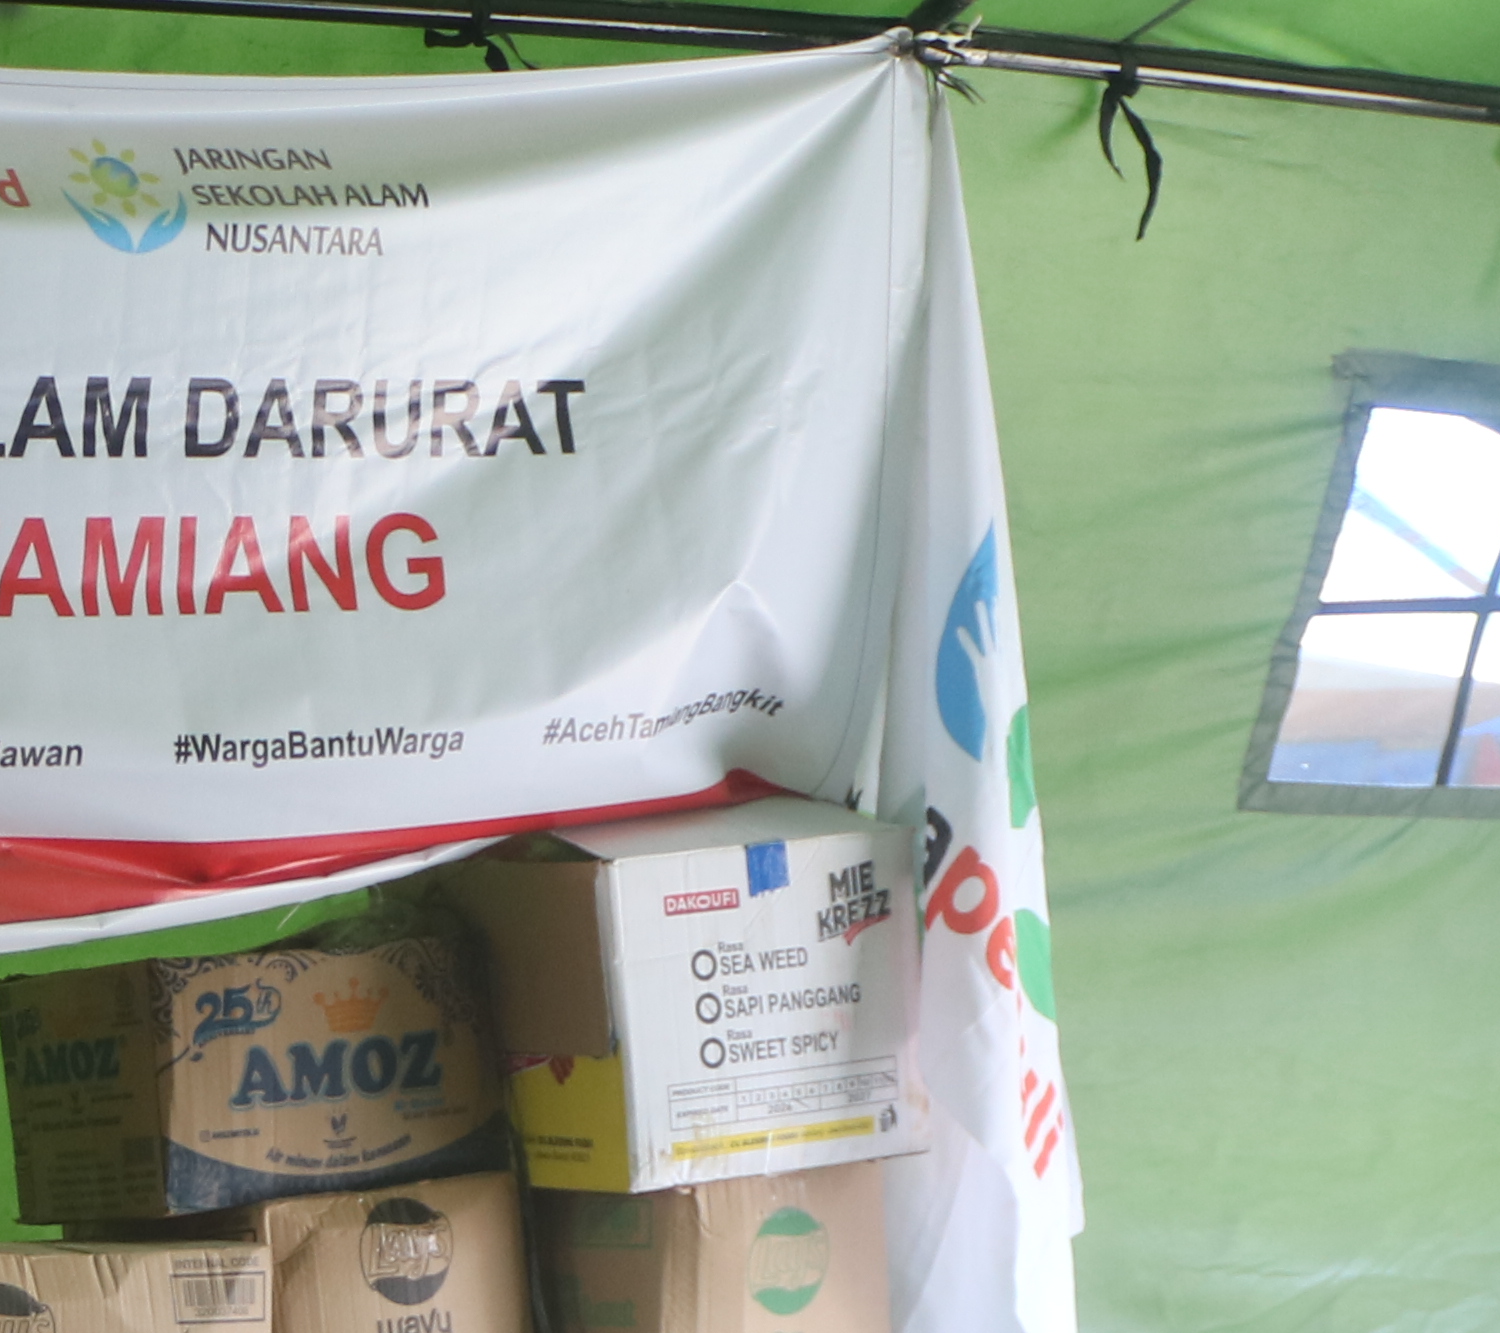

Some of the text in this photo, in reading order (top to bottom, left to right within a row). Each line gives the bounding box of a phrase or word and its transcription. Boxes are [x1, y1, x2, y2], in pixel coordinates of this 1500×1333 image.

[174, 146, 333, 174] JARINGAN
[191, 183, 430, 209] SEKOLAH ALAM
[206, 224, 383, 256] NUSANTARA
[184, 377, 587, 459] DARURAT
[173, 725, 464, 768] #WargaBantuWarga
[829, 860, 873, 901] MIE
[666, 891, 738, 913] DAKOUFI
[817, 889, 891, 939] KREZZ
[720, 947, 808, 975] SEA WEED
[725, 983, 861, 1019] SAPI PANGGANG
[728, 1031, 839, 1063] SWEET SPICY
[229, 1031, 444, 1111] AMOZ
